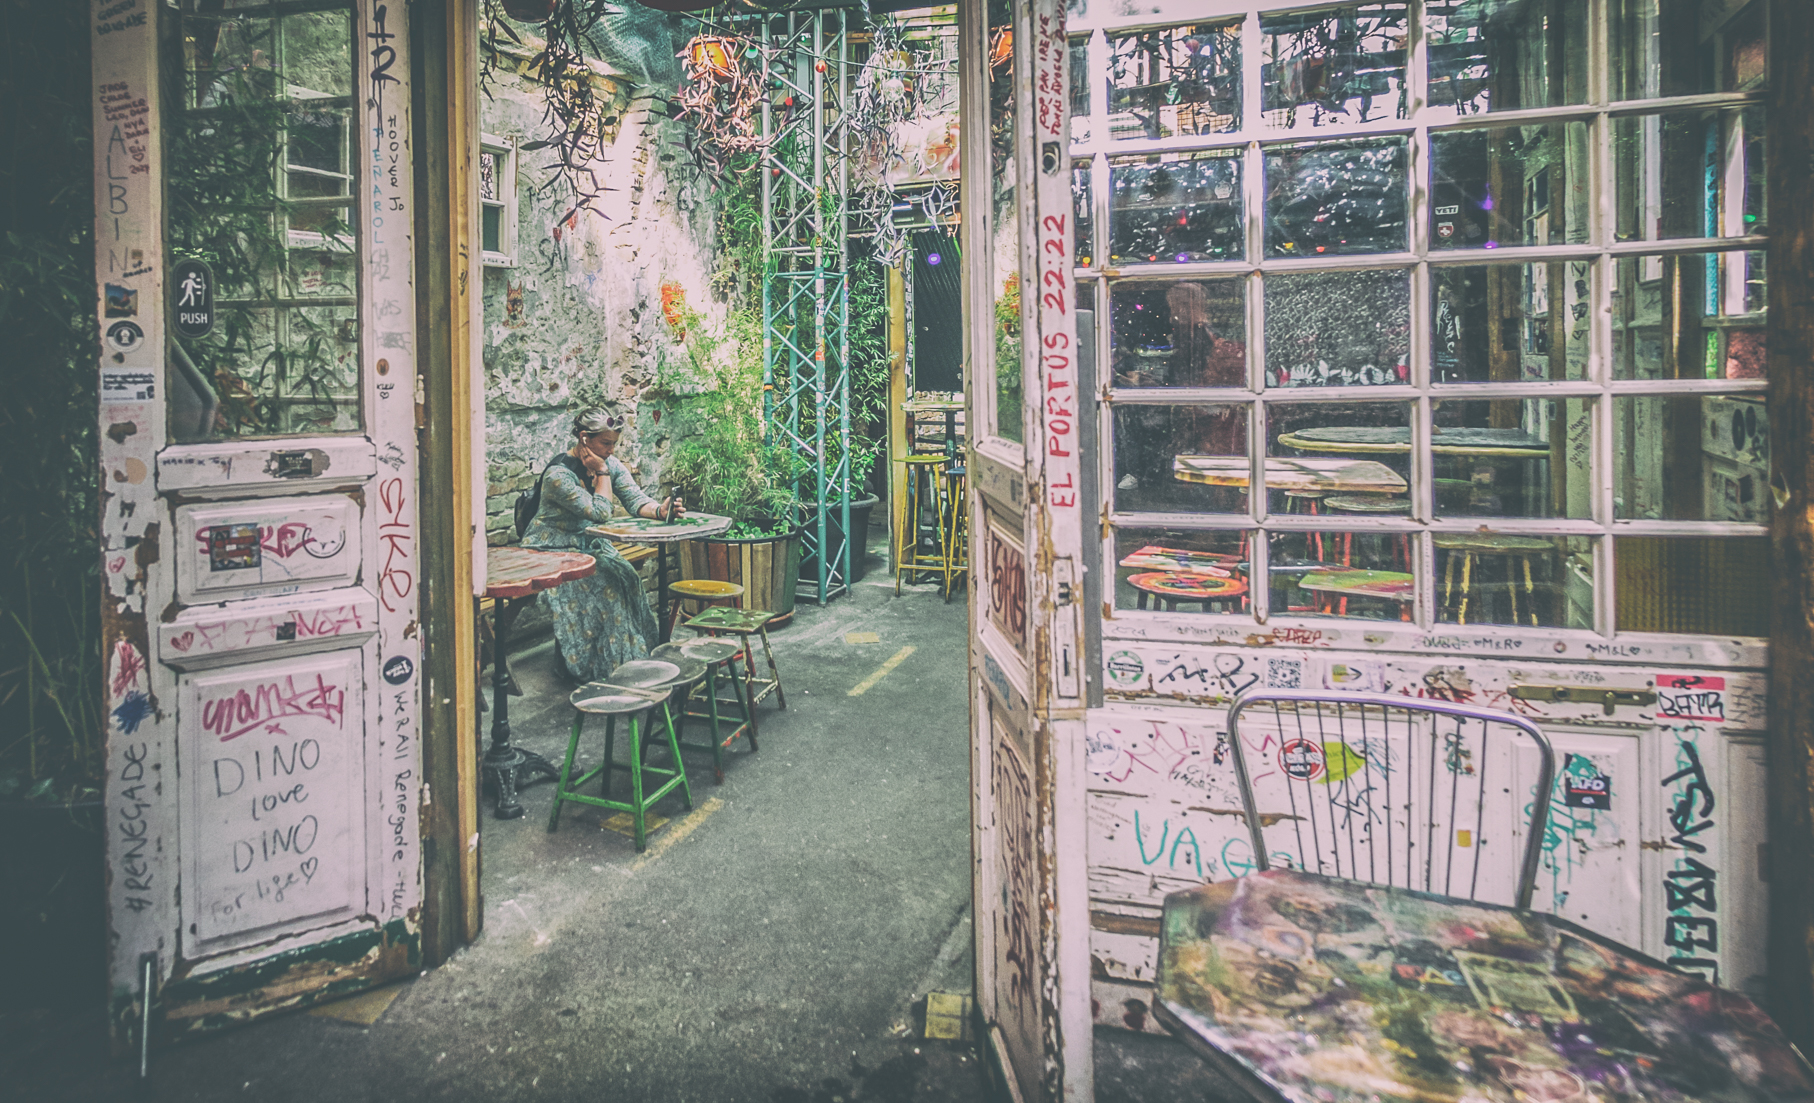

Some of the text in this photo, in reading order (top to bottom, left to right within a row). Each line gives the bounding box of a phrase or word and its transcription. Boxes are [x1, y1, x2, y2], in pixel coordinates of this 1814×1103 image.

[387, 114, 400, 188] HOOVER
[180, 312, 208, 325] PUSH
[1050, 472, 1076, 508] EL
[212, 737, 321, 798] DINO
[119, 741, 152, 915] #RENEGADE
[232, 815, 319, 874] DINO
